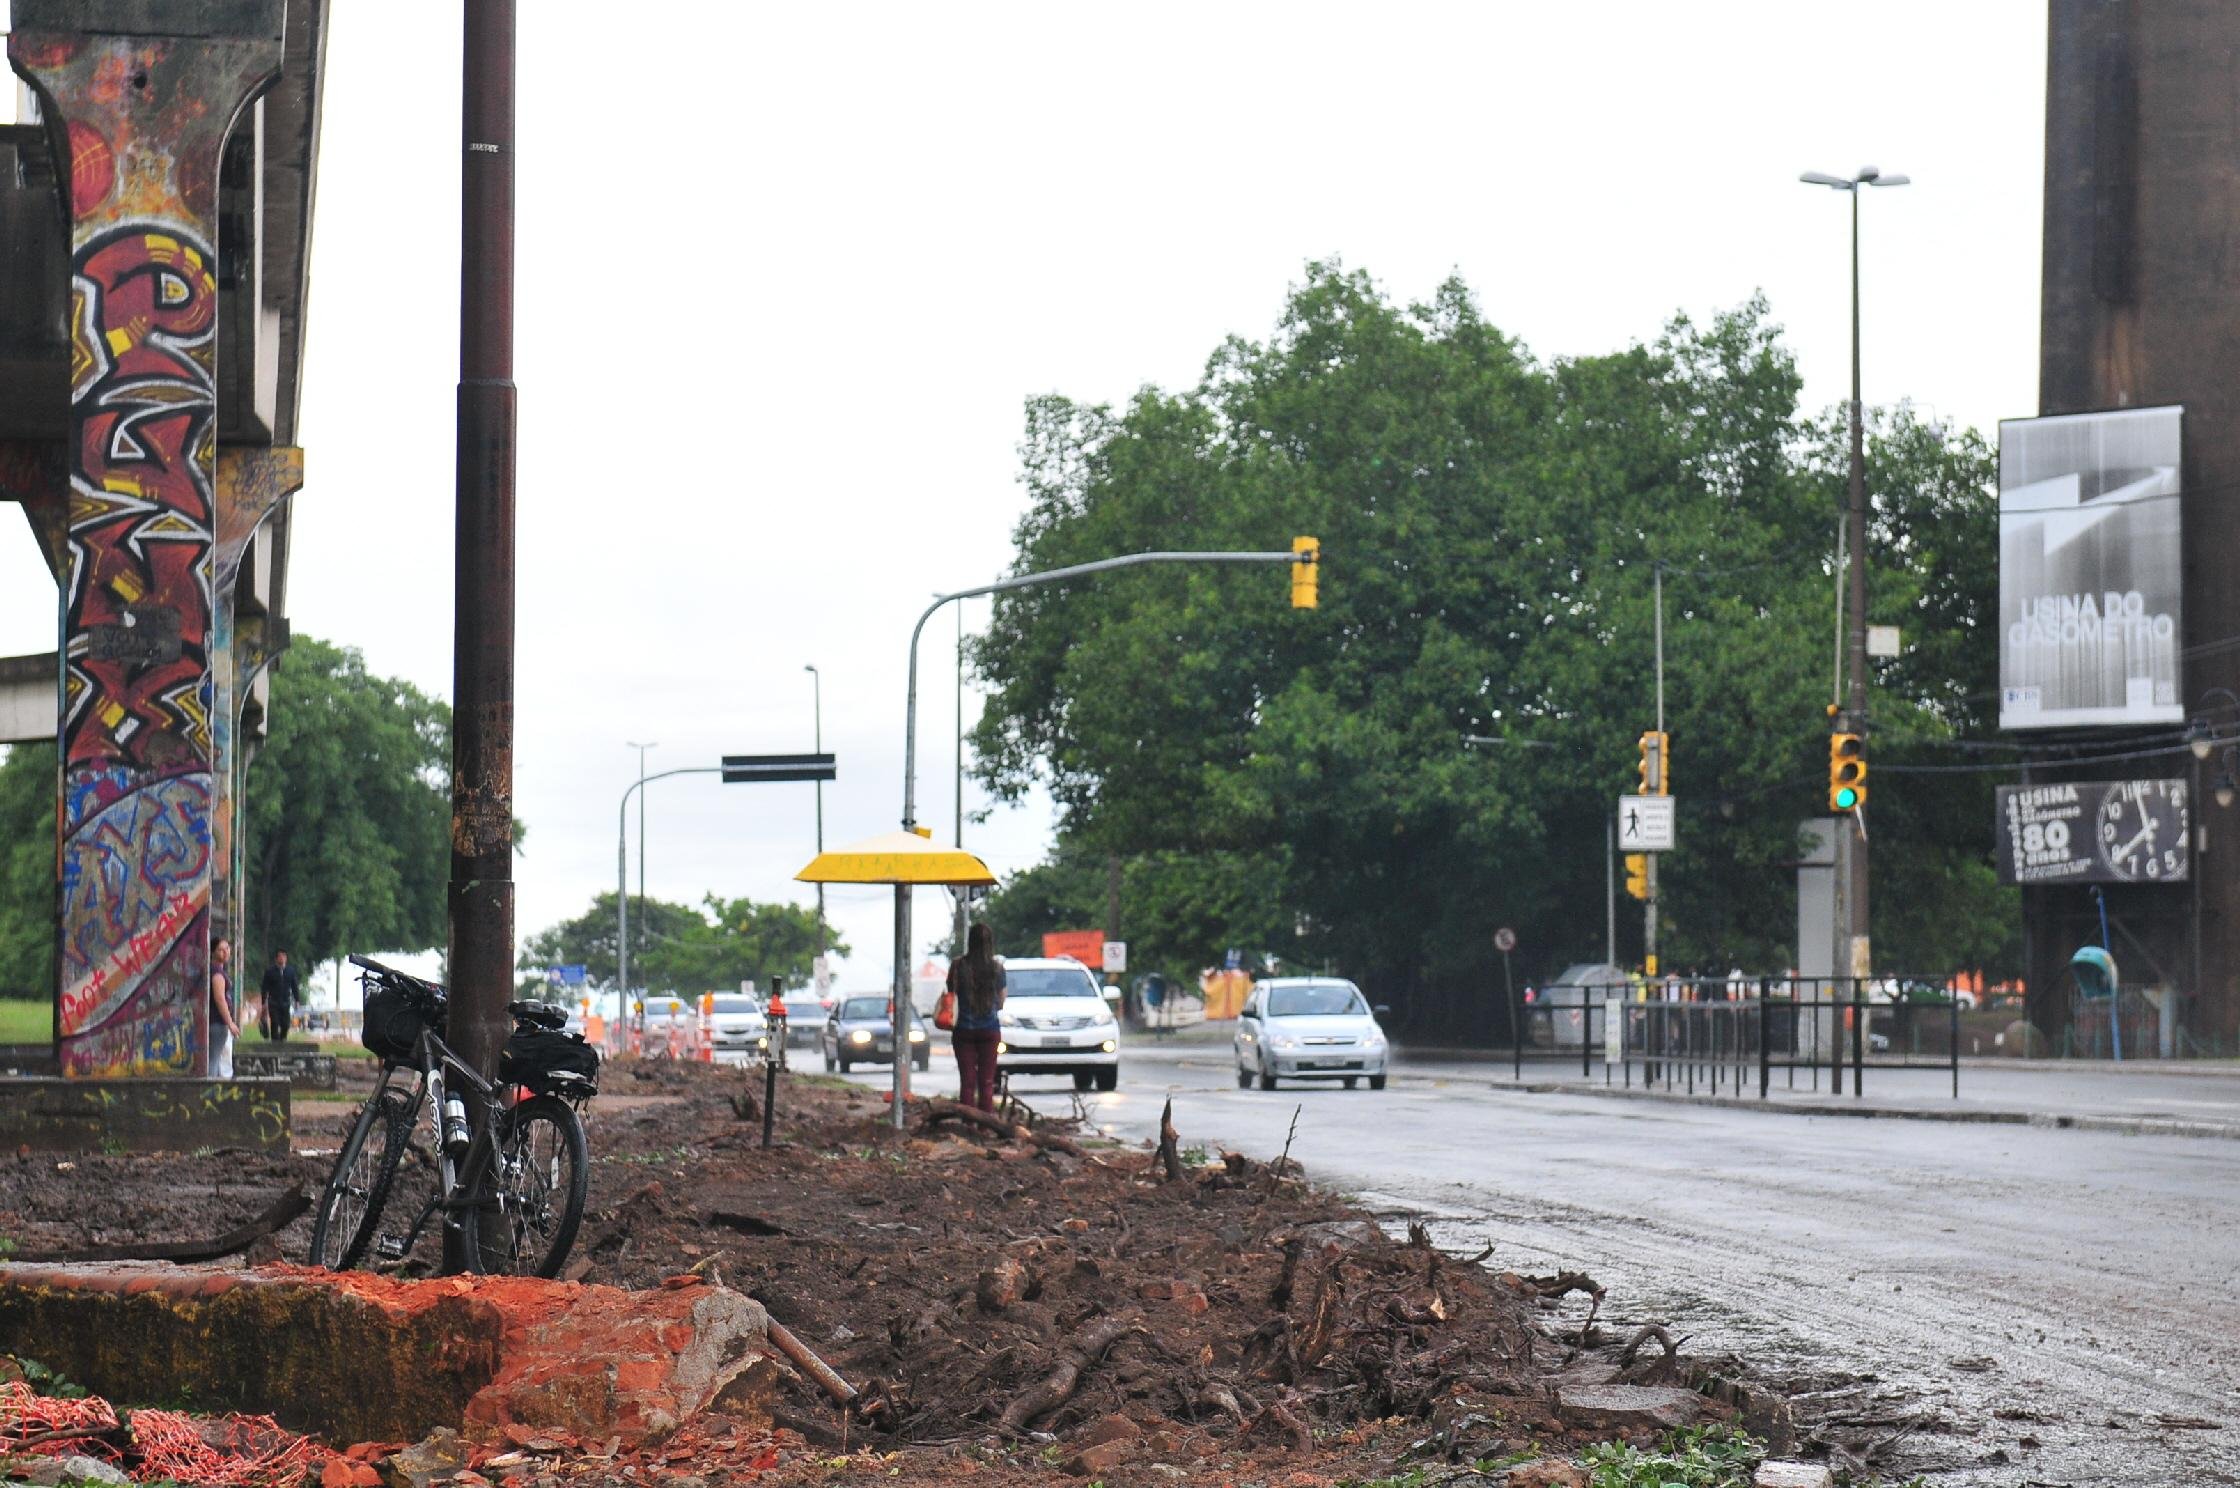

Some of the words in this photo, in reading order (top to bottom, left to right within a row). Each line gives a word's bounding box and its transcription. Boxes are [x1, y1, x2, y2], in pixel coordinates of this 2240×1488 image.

[2021, 593, 2098, 623] USINA
[2104, 590, 2144, 619] DO
[2019, 784, 2079, 806] USINA
[2106, 801, 2122, 820] 10
[2022, 819, 2069, 852] 80
[2103, 823, 2115, 842] 9
[2127, 854, 2138, 875] 7
[2145, 857, 2158, 879] 6
[2164, 849, 2177, 872] 5
